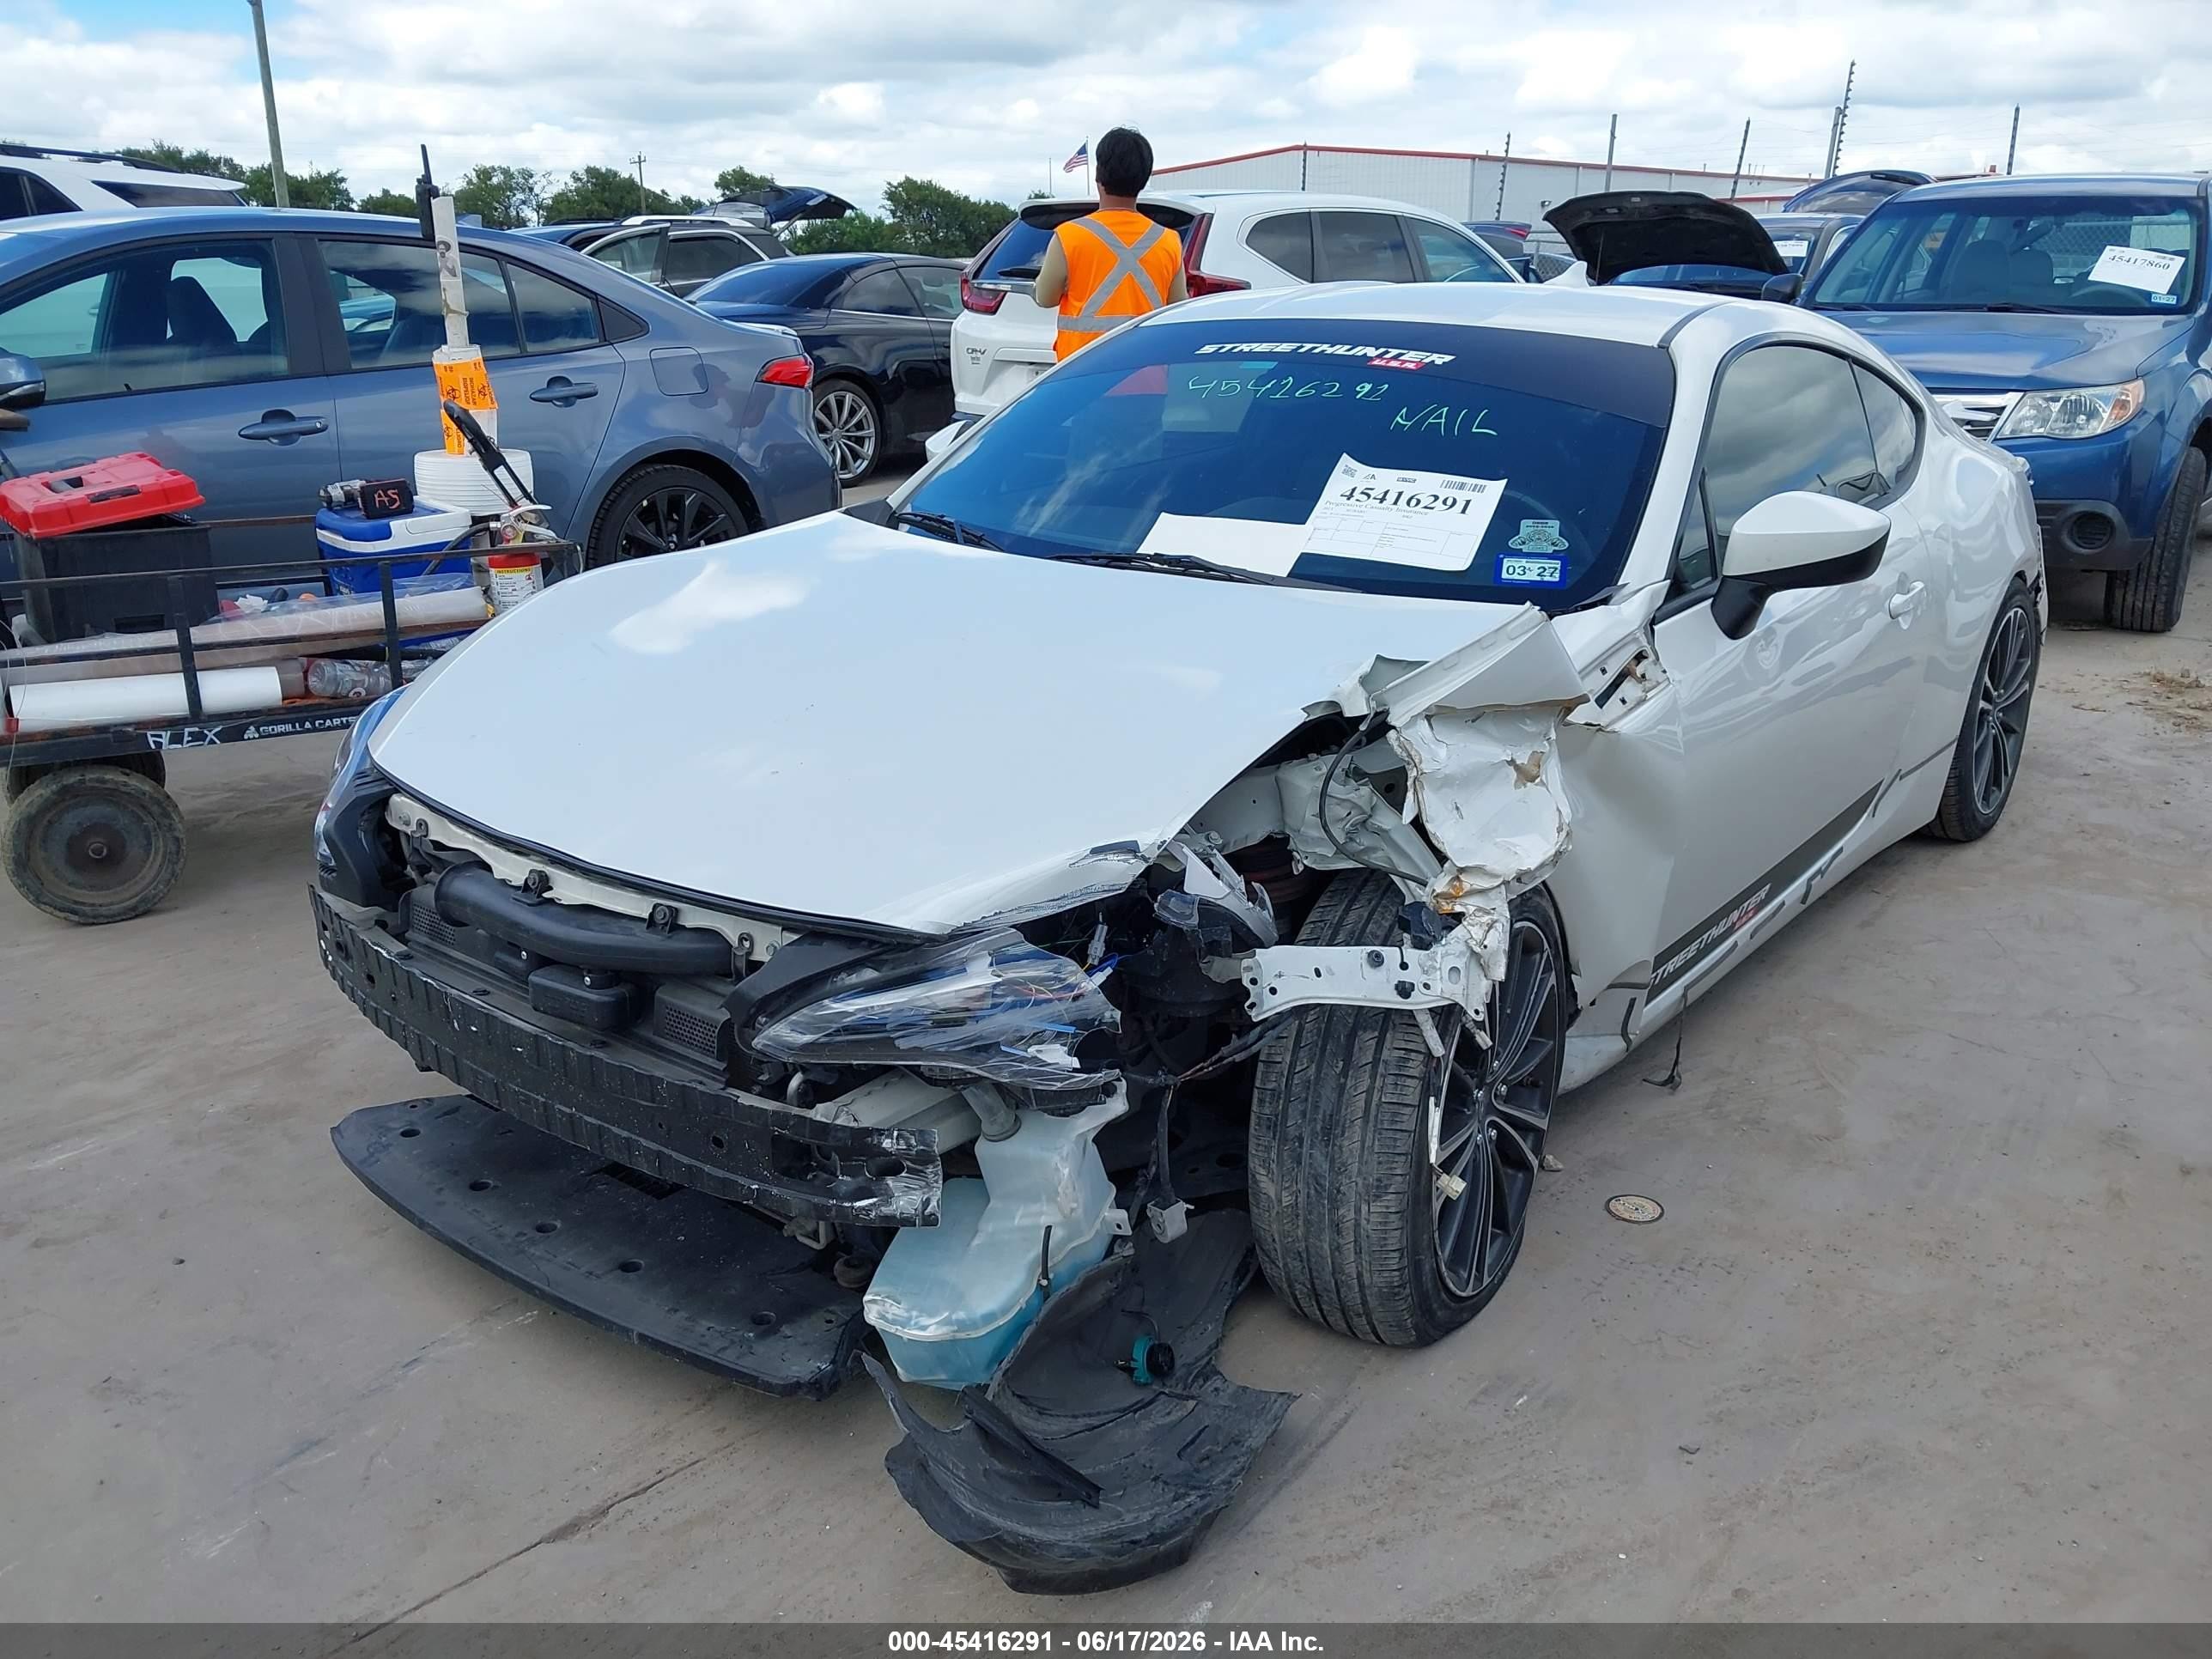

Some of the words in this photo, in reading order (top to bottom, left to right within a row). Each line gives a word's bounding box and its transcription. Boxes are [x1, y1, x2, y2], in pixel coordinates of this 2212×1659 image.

[2108, 254, 2171, 270] 45417860
[1194, 343, 1457, 365] STREETHUNTER
[1389, 404, 1498, 436] NAIL
[1340, 486, 1473, 515] 45416291
[1395, 507, 1429, 516] Insurance
[146, 726, 223, 750] ALEX
[259, 723, 312, 736] GORILLA
